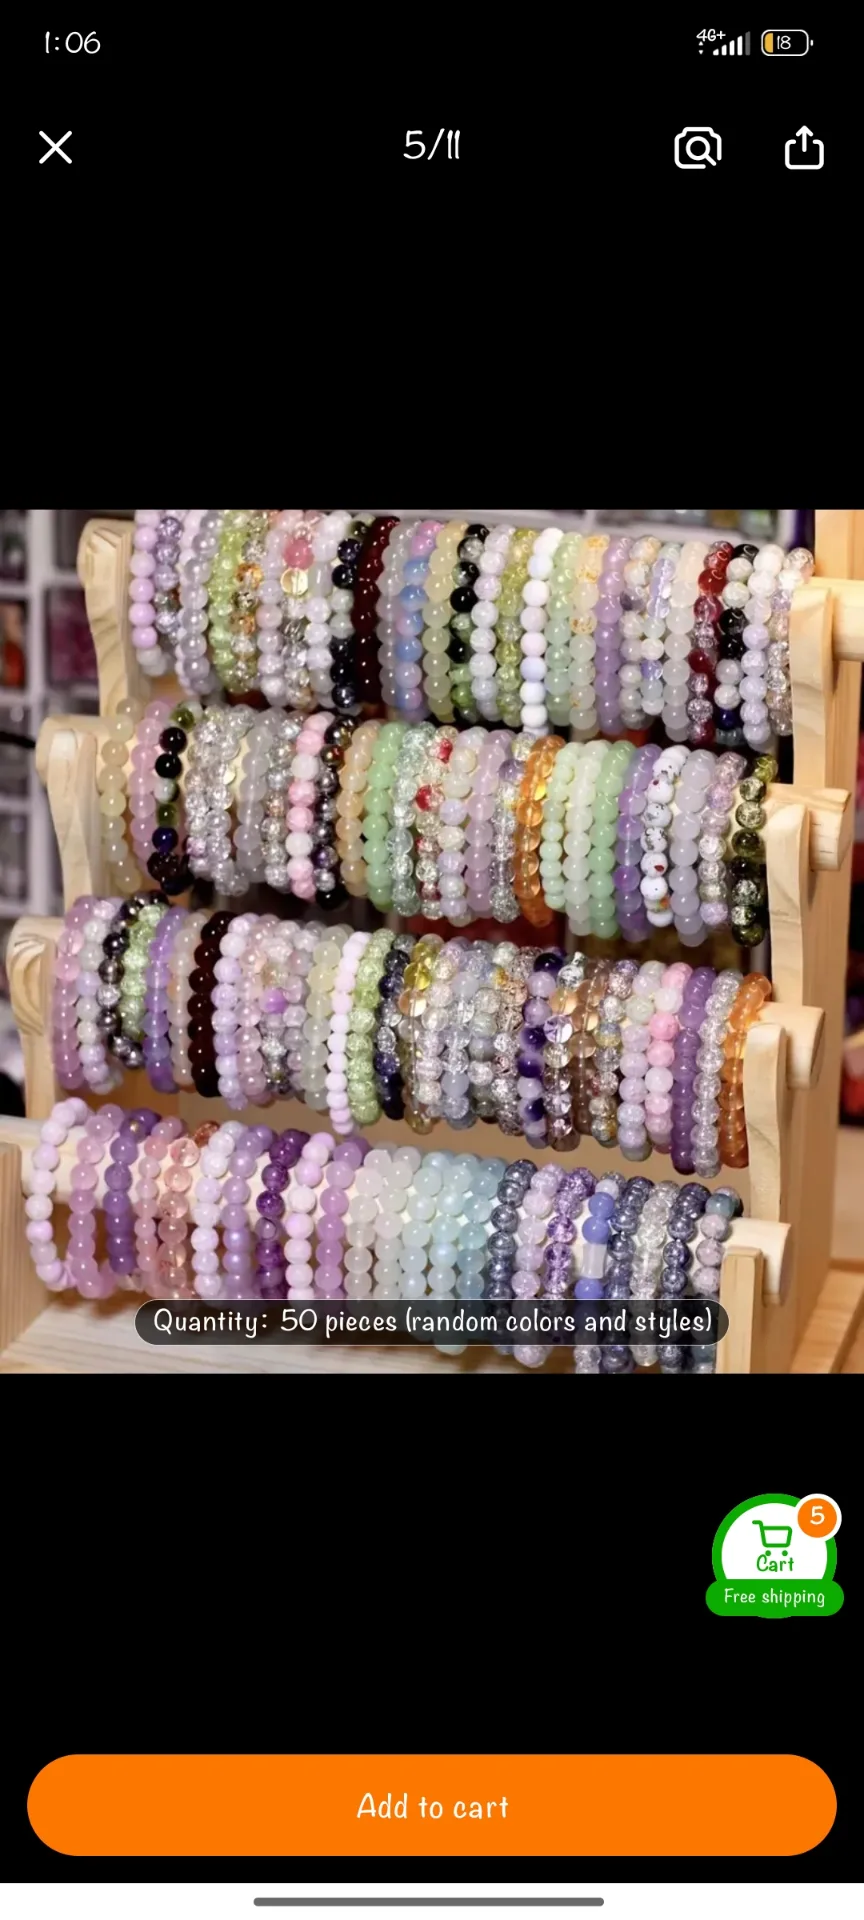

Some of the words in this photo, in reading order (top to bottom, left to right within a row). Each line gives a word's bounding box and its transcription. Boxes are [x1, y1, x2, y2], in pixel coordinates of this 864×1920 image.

[44, 31, 101, 55] 1:06
[777, 35, 792, 50] 18
[403, 128, 461, 161] 5/11
[809, 1505, 826, 1525] 5
[756, 1554, 795, 1573] Cart
[724, 1587, 756, 1604] Free
[762, 1587, 825, 1608] shipping
[356, 1792, 408, 1819] Add
[418, 1796, 443, 1819] to
[453, 1796, 509, 1820] cart
